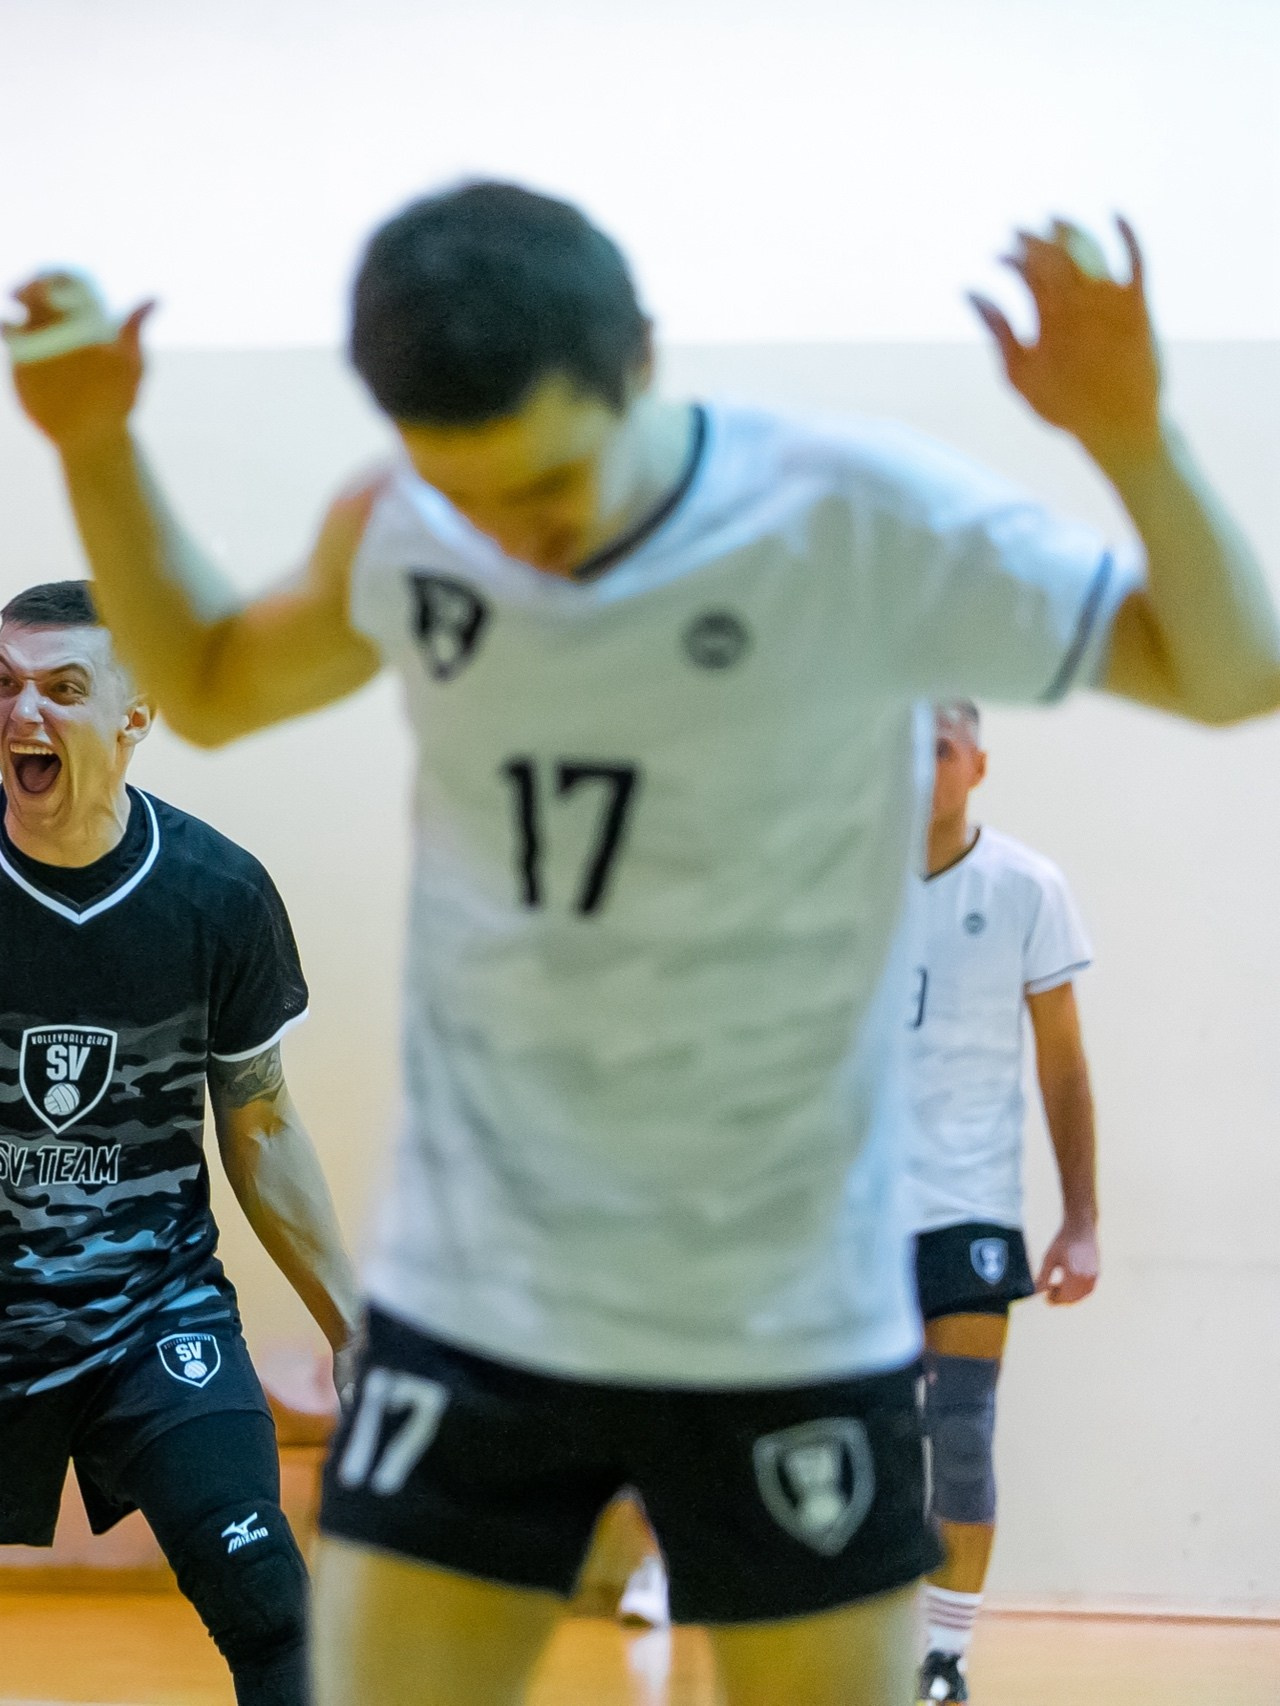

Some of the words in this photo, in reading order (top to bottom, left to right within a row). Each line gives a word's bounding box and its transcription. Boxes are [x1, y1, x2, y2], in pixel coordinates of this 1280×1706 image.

[502, 756, 638, 915] 17
[86, 1035, 109, 1046] CLUB
[46, 1044, 91, 1081] SV
[36, 1144, 121, 1186] TEAM
[175, 1341, 202, 1362] SV
[339, 1367, 450, 1494] 17
